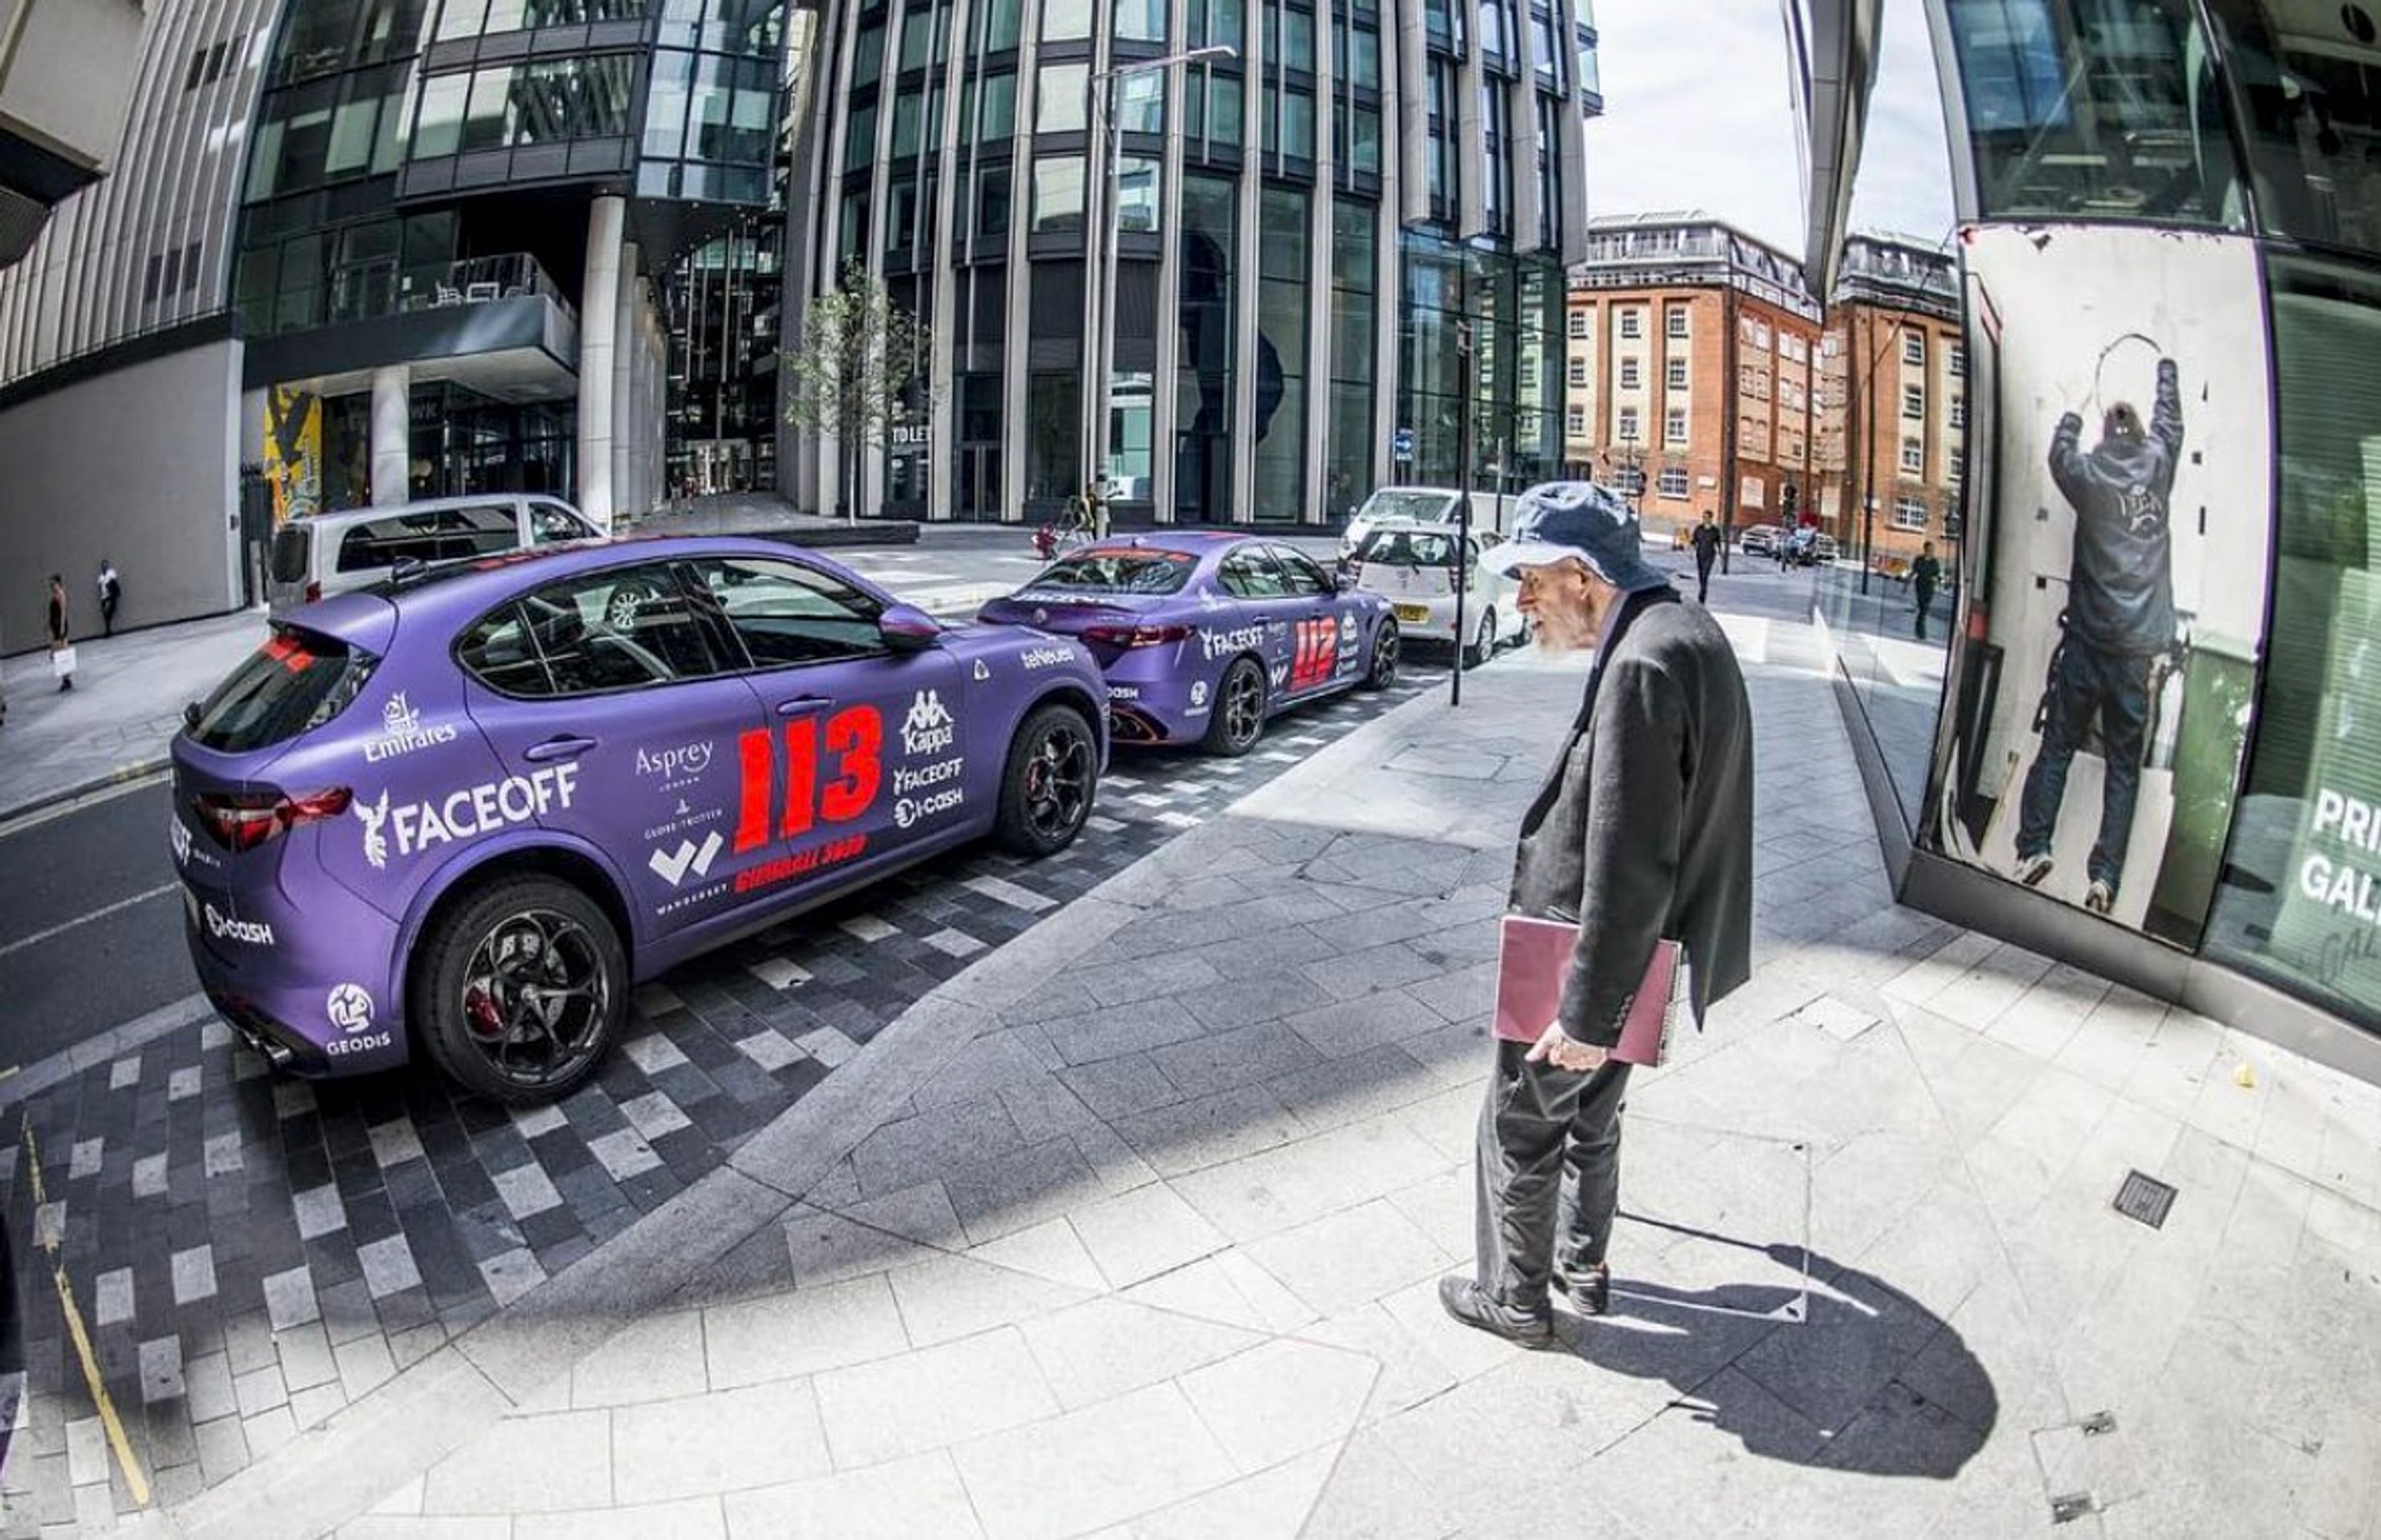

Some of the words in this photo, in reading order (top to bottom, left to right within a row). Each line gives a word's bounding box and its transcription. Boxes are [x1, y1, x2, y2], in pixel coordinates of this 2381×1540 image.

[1213, 626, 1264, 656] FACEOFF
[363, 723, 457, 762] Emirates
[635, 740, 713, 778] Asprey
[904, 724, 953, 756] Kappa
[734, 705, 882, 854] 113
[903, 757, 963, 792] FACEOFF
[391, 762, 579, 856] FACEOFF
[2312, 786, 2381, 856] PRI
[2301, 853, 2381, 926] GAL
[326, 1031, 391, 1056] GEODIS
